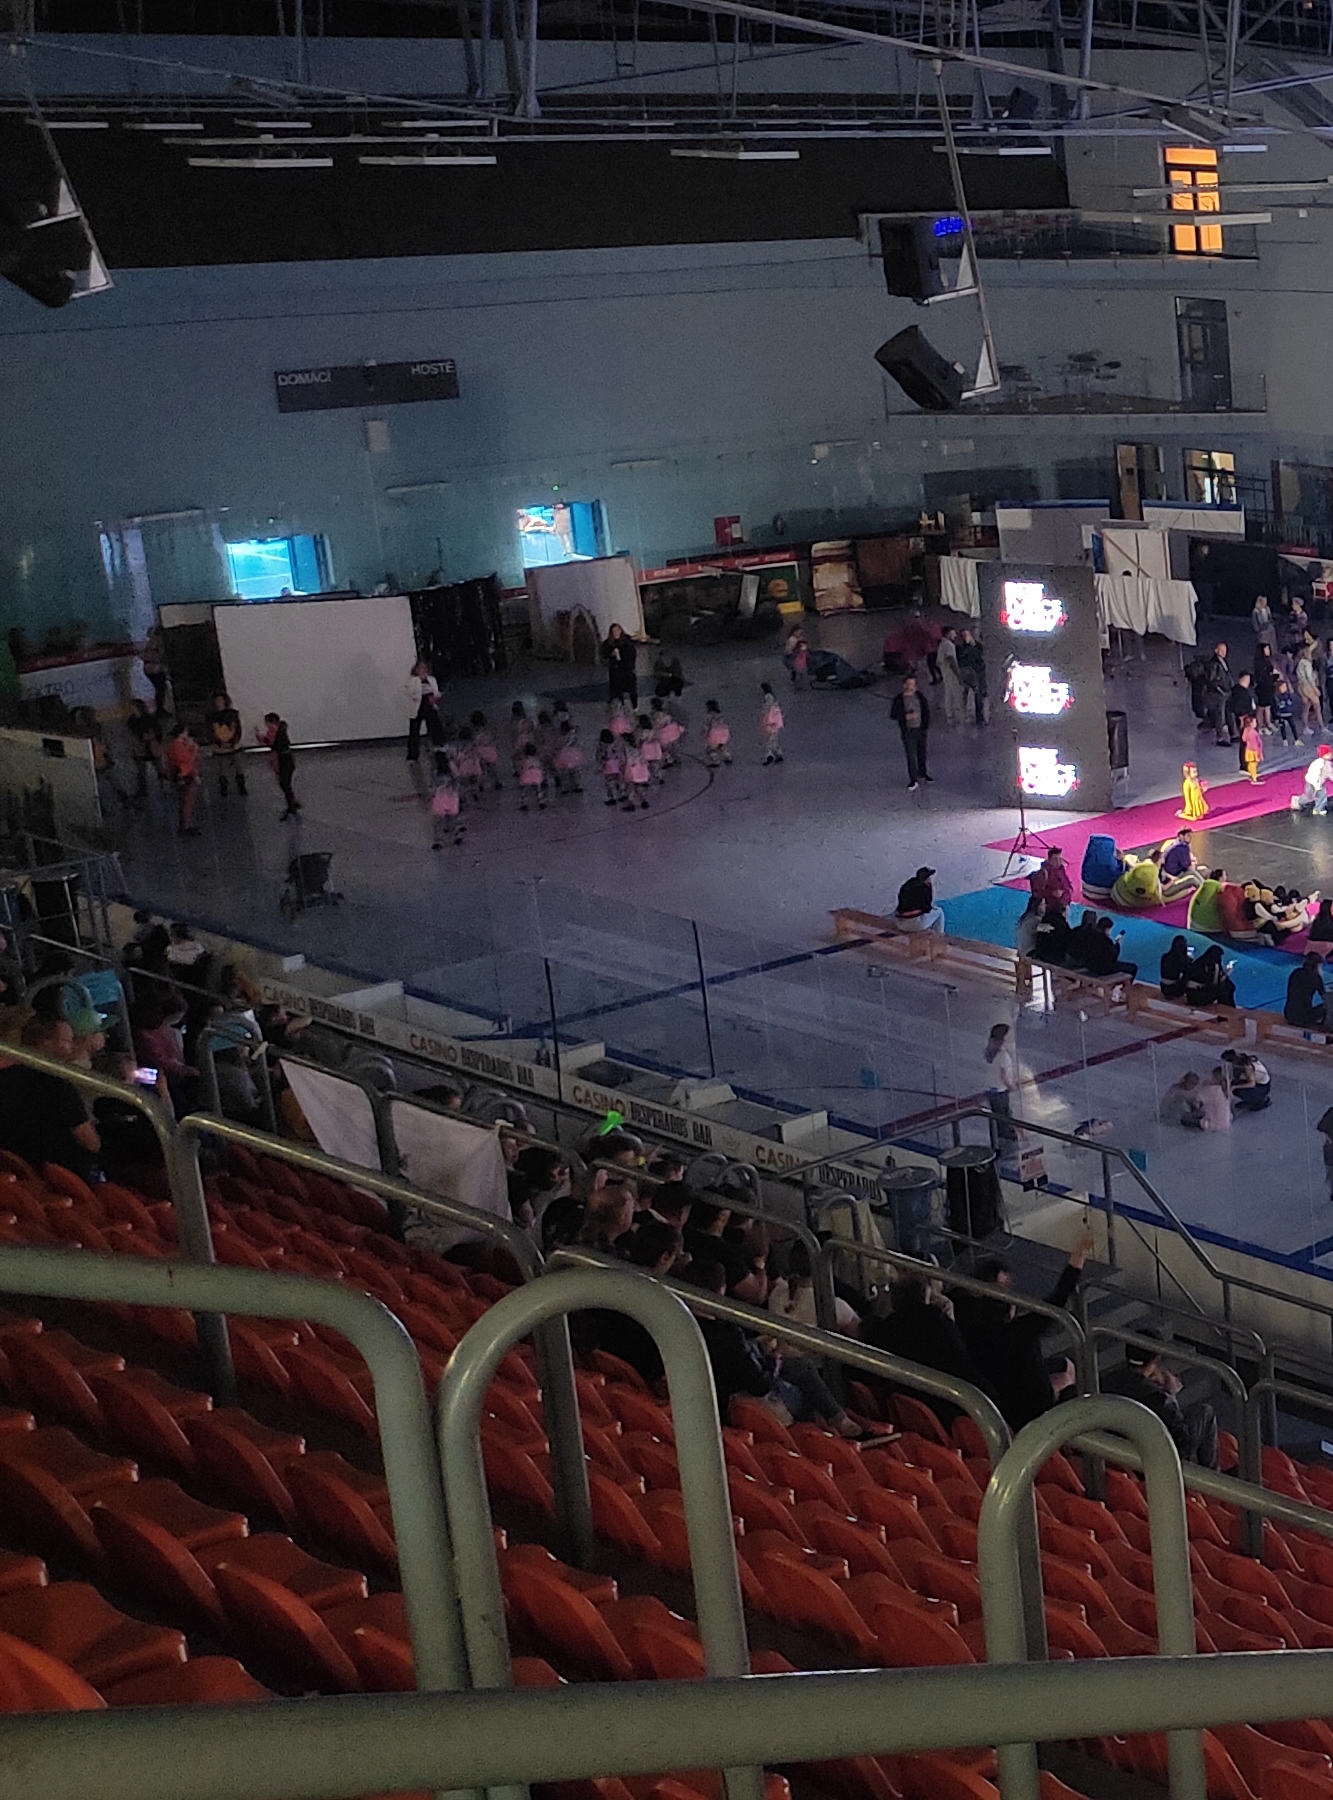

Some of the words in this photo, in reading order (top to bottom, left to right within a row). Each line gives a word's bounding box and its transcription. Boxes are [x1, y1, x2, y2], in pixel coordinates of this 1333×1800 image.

[410, 1033, 458, 1063] CASINO
[573, 1084, 626, 1116] CASINO
[631, 1101, 689, 1139] DESPERADOS
[693, 1120, 714, 1147] BAR
